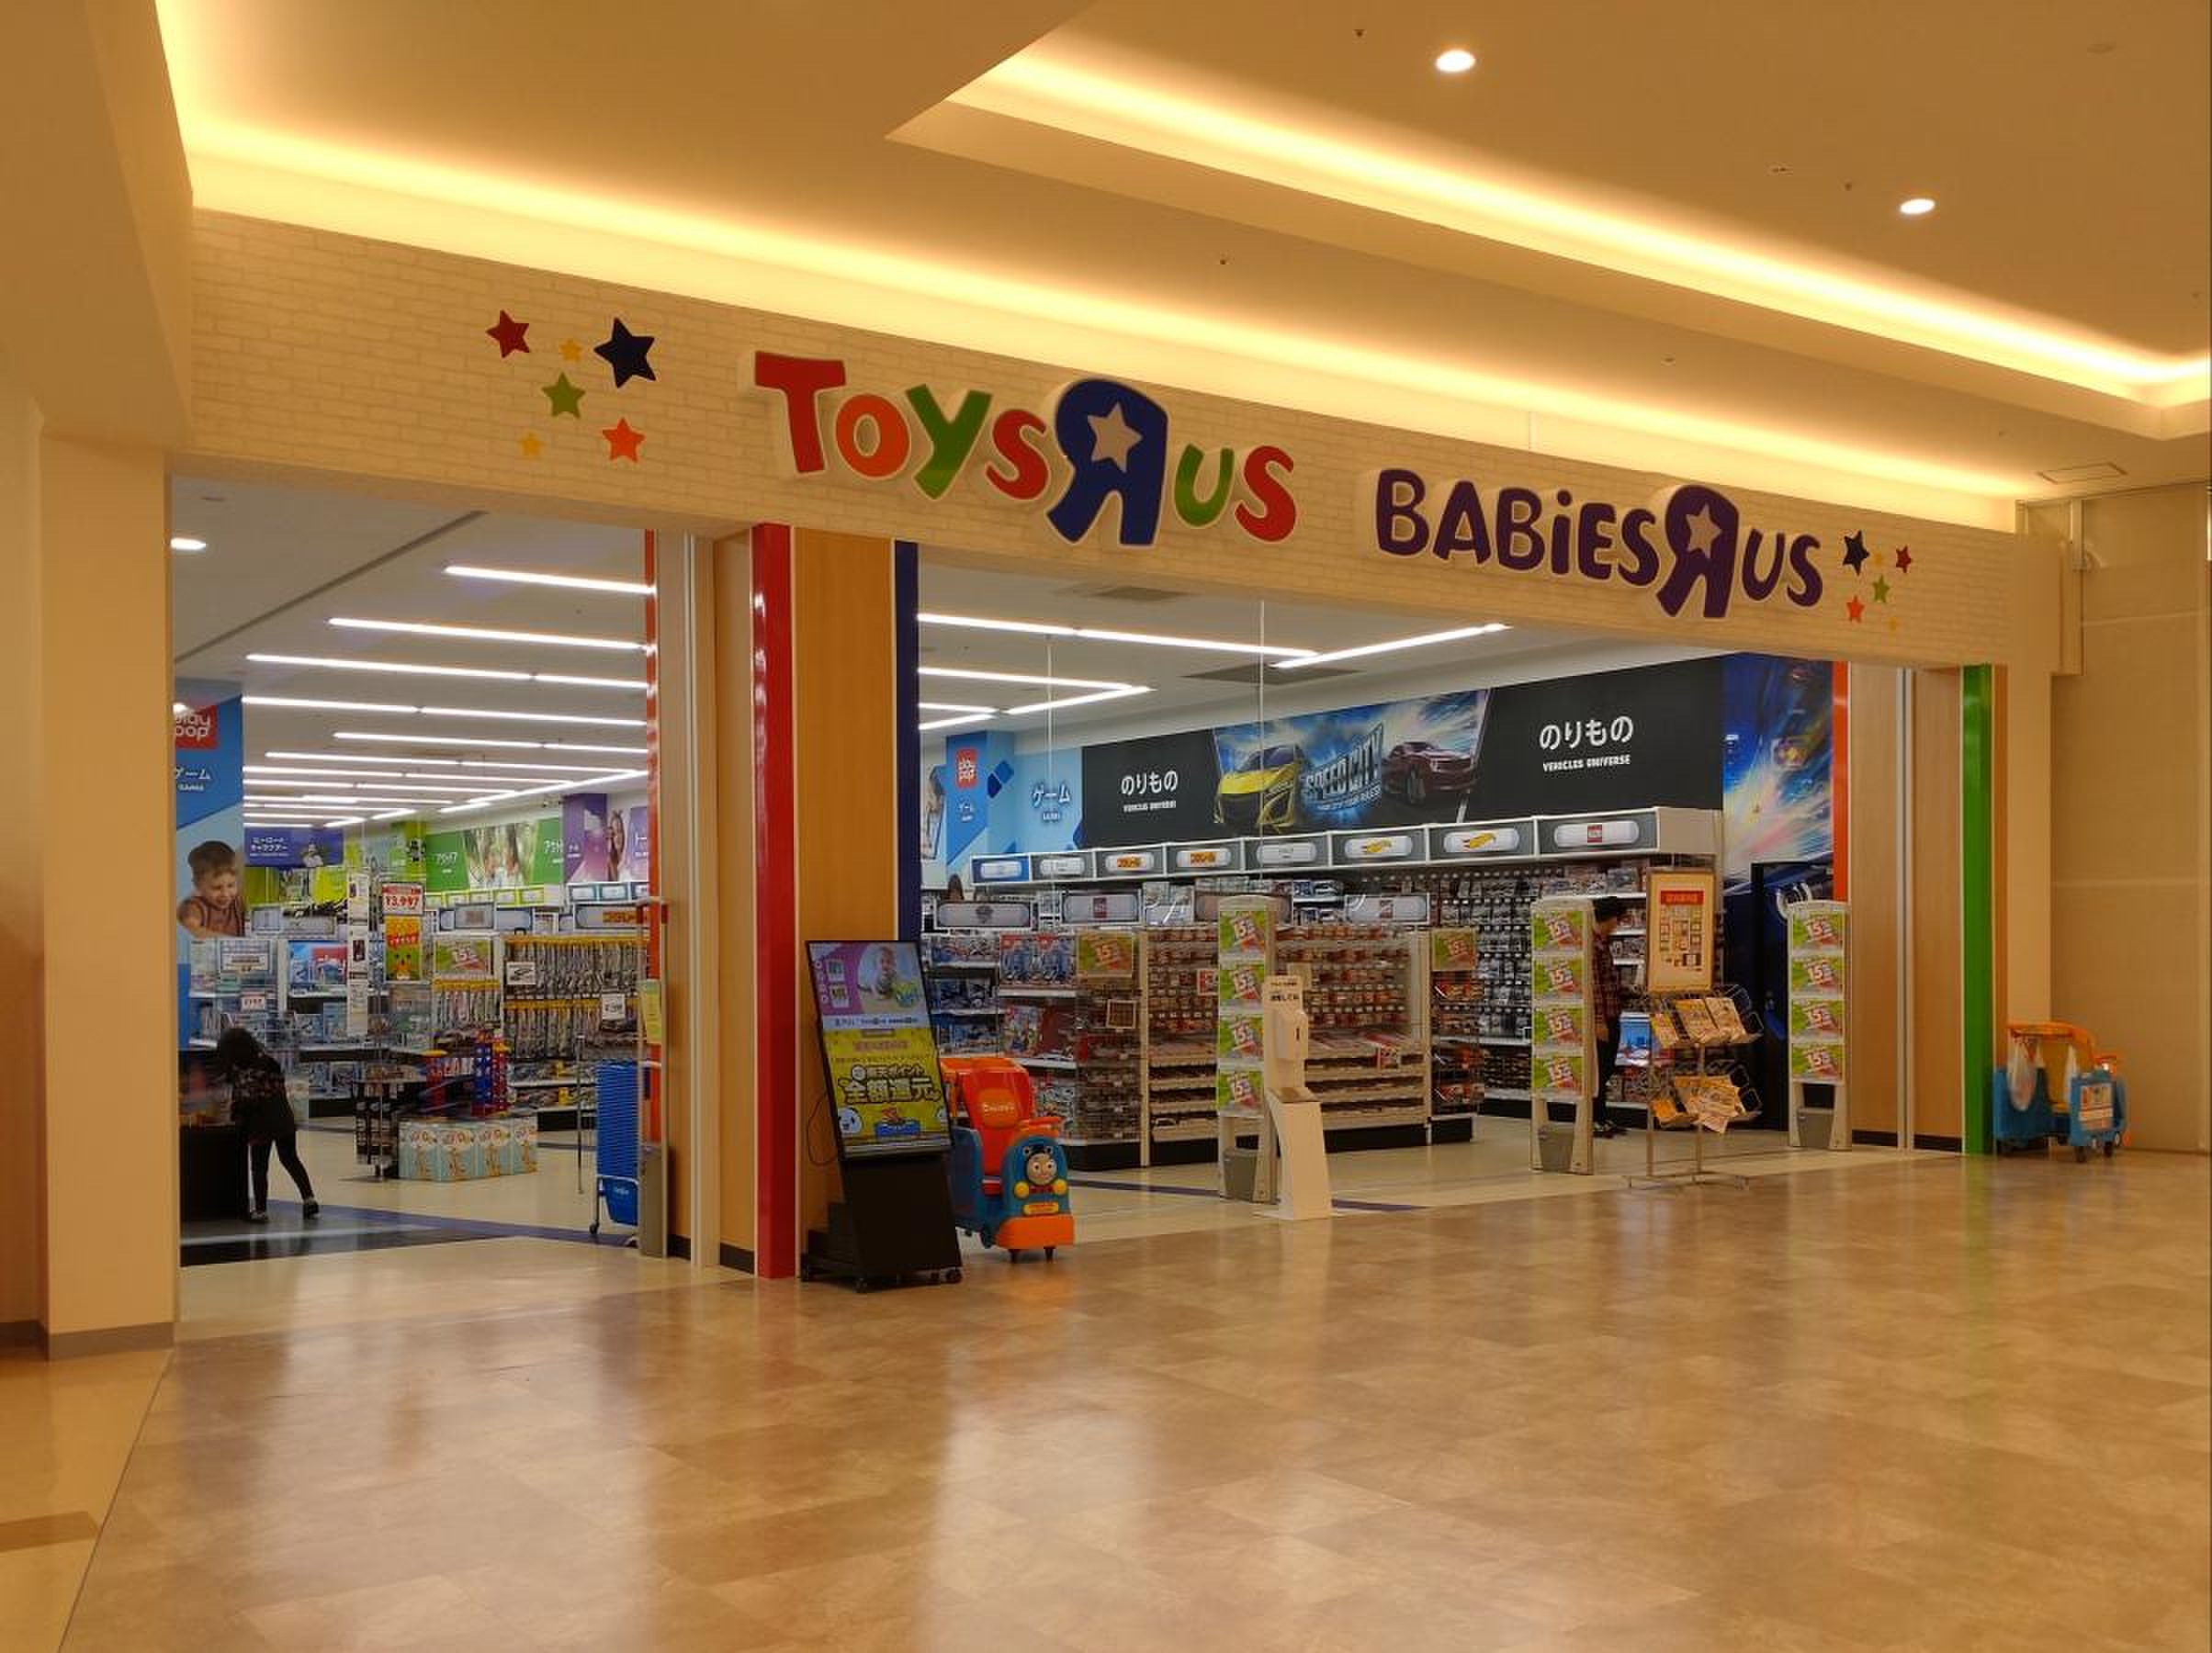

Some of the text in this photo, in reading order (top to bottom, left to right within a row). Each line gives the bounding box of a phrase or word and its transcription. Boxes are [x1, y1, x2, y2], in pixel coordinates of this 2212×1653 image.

[1540, 716, 1633, 750] のりもの
[1121, 770, 1178, 796] のりもの
[1306, 756, 1348, 798] SPEED
[1032, 783, 1071, 808] ゲーム
